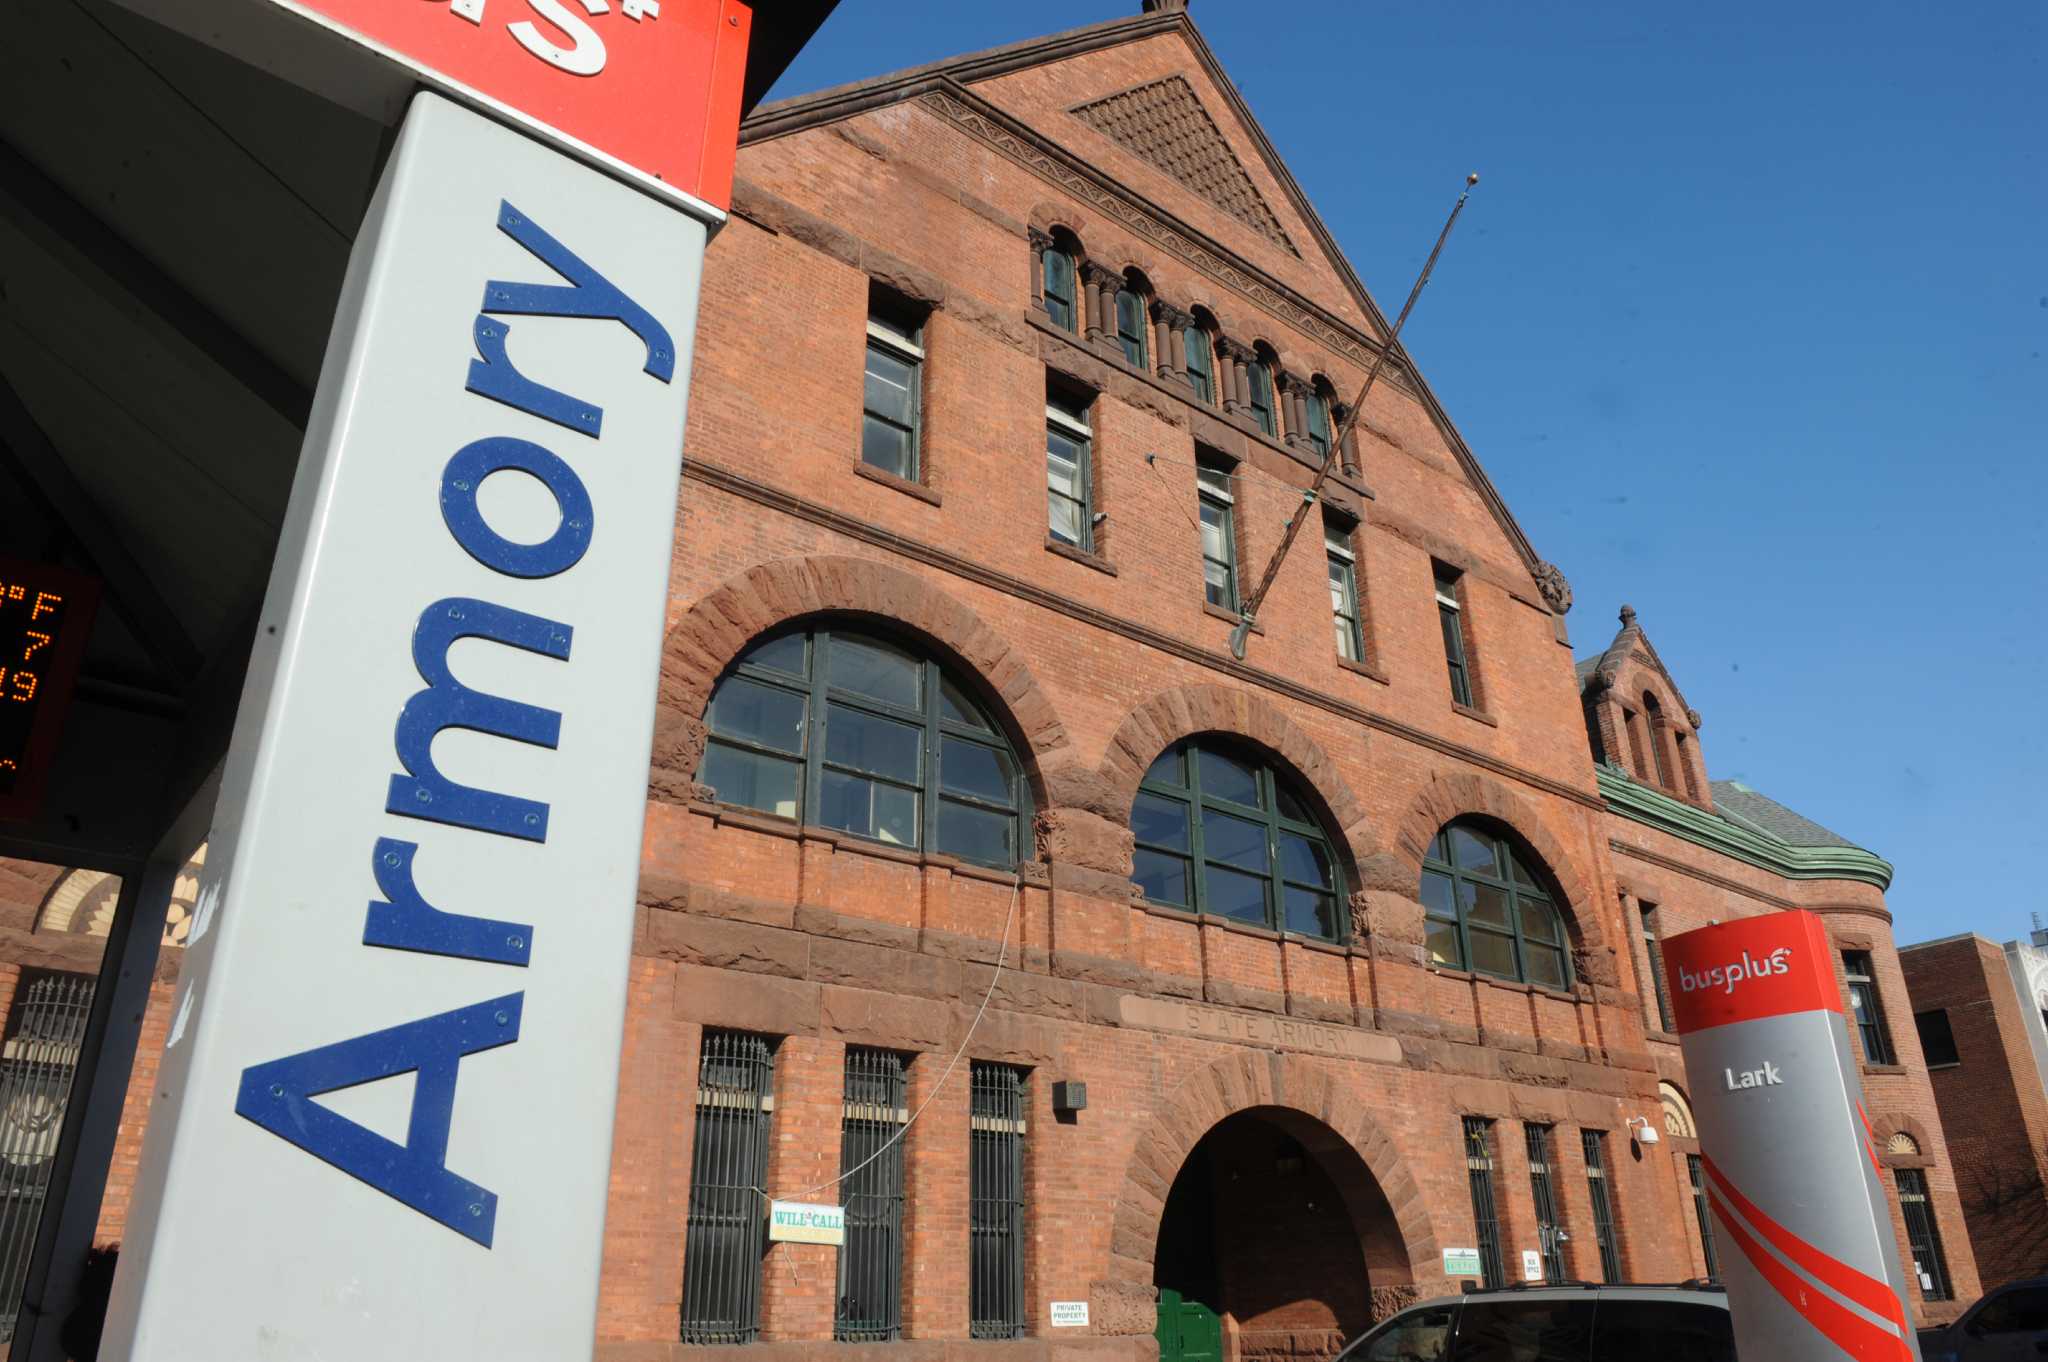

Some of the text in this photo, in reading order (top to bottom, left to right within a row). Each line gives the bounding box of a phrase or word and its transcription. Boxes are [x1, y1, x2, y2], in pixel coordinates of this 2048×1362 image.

[235, 198, 676, 1250] Armory
[1185, 1006, 1349, 1050] STATE ARMORY
[1724, 1061, 1784, 1091] Lark
[774, 1211, 844, 1229] WILL CALL
[1053, 1311, 1086, 1319] PROPERTY
[1056, 1303, 1082, 1312] PRIVATE
